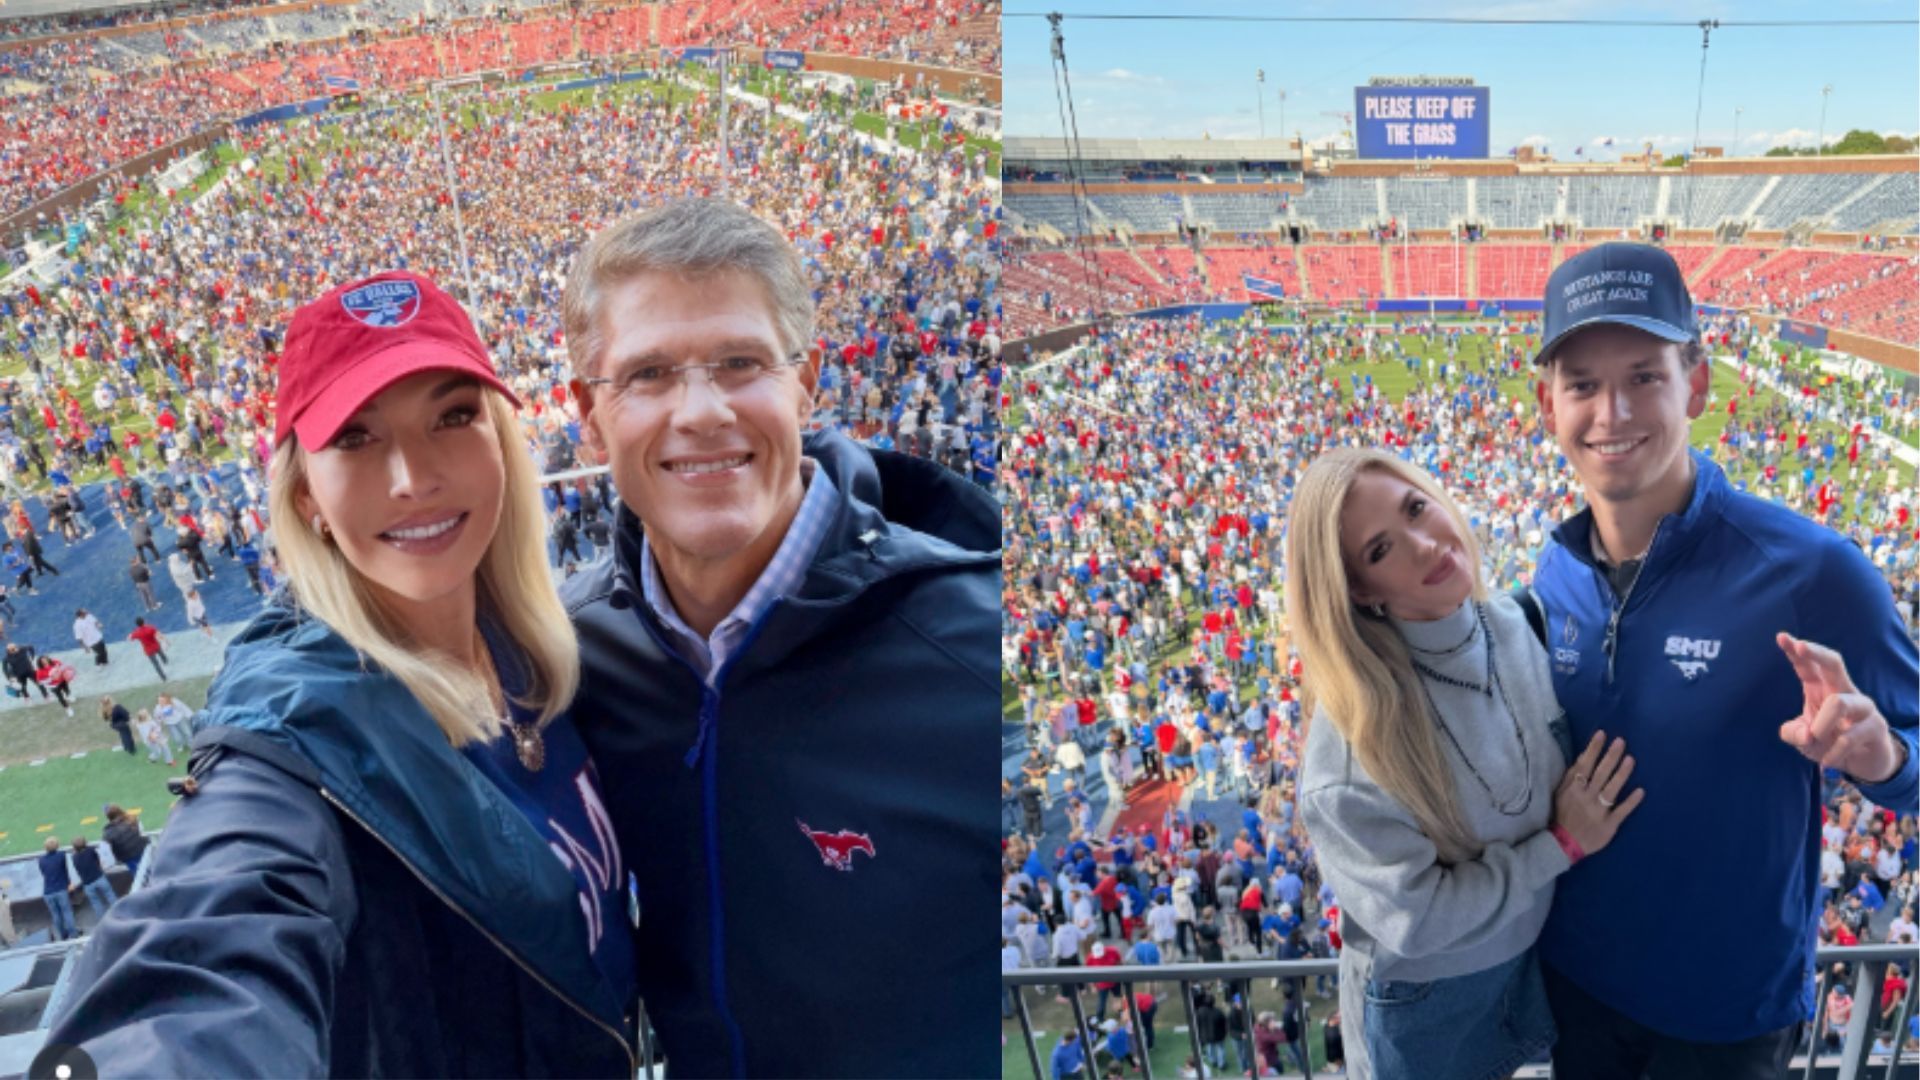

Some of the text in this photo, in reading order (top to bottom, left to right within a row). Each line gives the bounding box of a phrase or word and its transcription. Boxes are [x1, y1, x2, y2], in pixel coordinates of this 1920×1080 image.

[1365, 96, 1476, 119] PLEASE KEEP OFF
[1385, 122, 1456, 145] THE GRASS
[365, 282, 413, 301] DALLAS
[1563, 271, 1653, 298] MUSTANGS ARE
[1567, 287, 1648, 313] GREAT AGAIN
[1664, 635, 1722, 659] SMU
